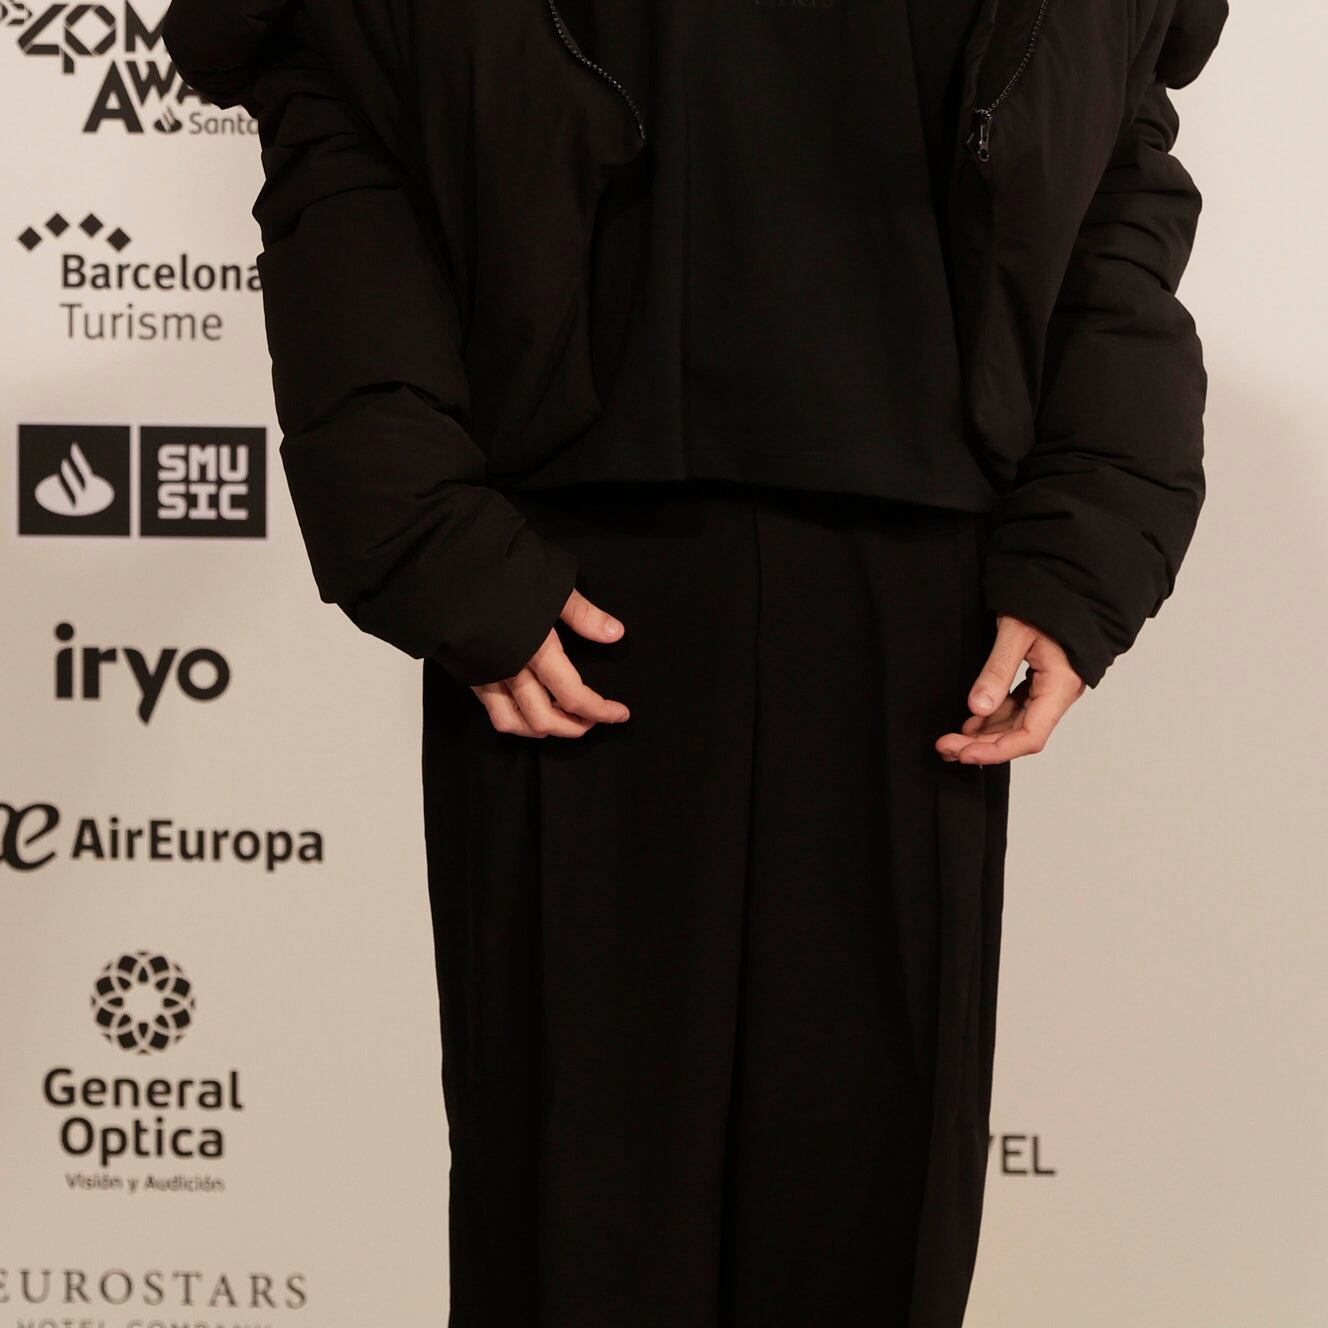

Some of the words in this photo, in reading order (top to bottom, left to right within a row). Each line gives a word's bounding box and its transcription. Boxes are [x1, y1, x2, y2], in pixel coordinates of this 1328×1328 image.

[189, 112, 259, 135] Santa
[60, 253, 264, 292] Barcelona
[60, 303, 223, 341] Turisme
[55, 621, 232, 727] iryo
[72, 817, 325, 872] AirEuropa
[44, 1067, 243, 1110] General
[60, 1117, 225, 1167] Optica
